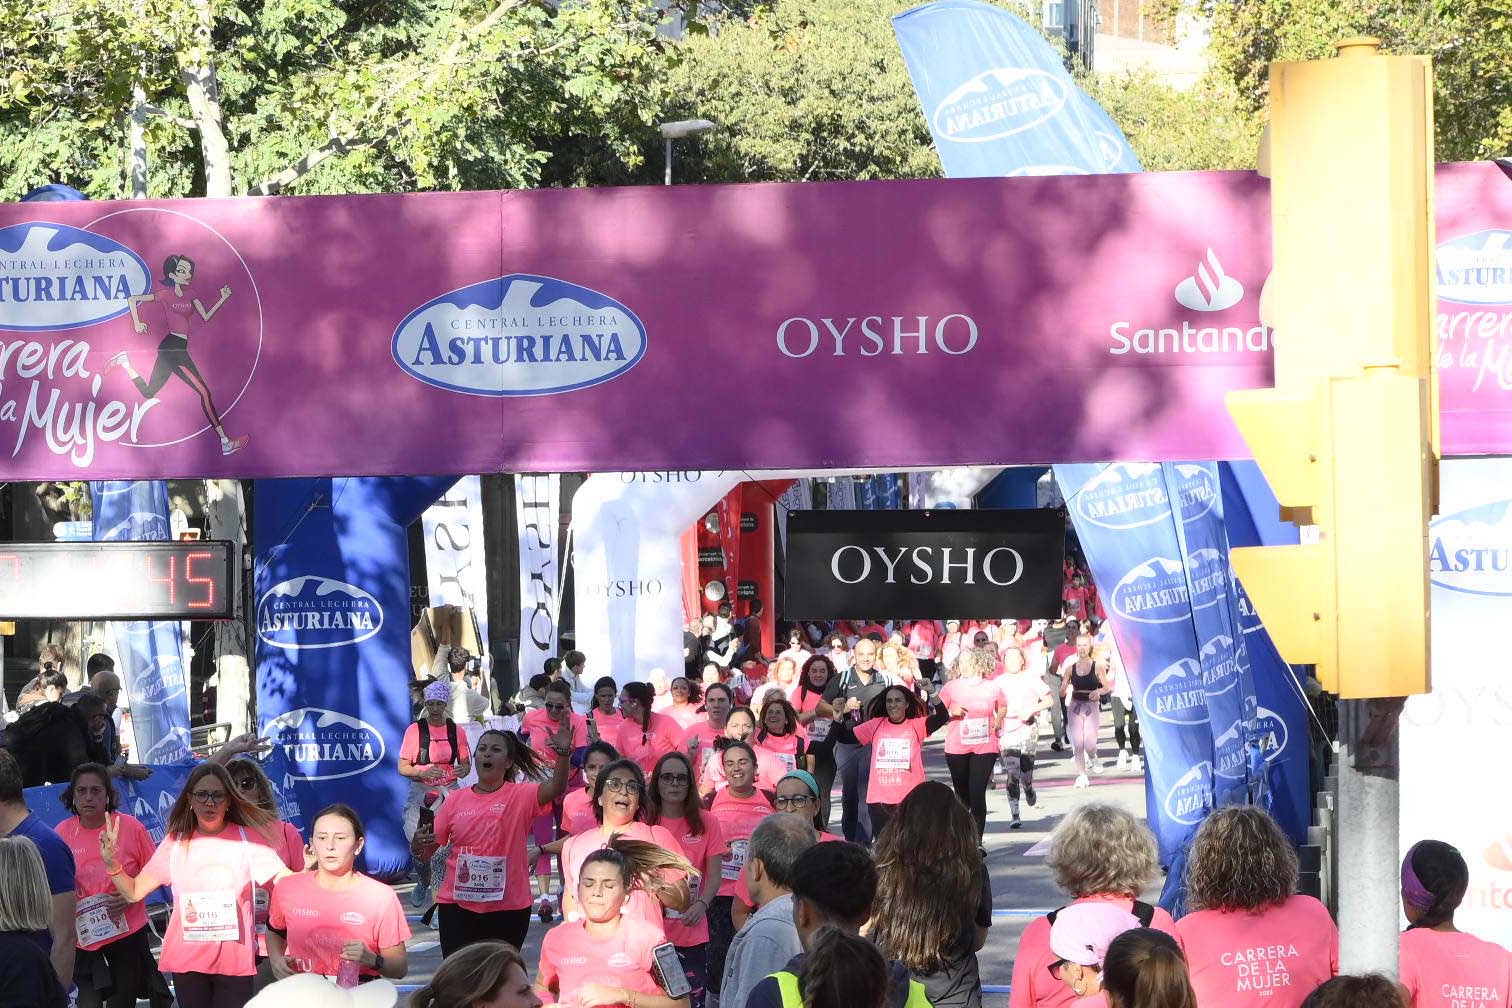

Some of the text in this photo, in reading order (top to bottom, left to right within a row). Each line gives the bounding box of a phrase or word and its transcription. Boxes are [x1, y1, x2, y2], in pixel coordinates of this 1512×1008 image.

[54, 257, 126, 270] LECHERA
[450, 314, 618, 330] CENTRAL LECHERA
[411, 321, 627, 367] ASTURIANA
[776, 313, 978, 358] OYSHO
[11, 373, 161, 468] Mujer
[831, 545, 1024, 586] OYSHO
[273, 600, 369, 610] CENTRAL LECHERA
[261, 605, 374, 632] ASTURIANA
[321, 732, 370, 741] LECHERA
[471, 874, 489, 882] 016
[1220, 944, 1299, 968] CARRERA
[1238, 958, 1287, 977] DE LA
[1236, 972, 1291, 993] MUJER
[1441, 983, 1499, 1001] CARRERA
